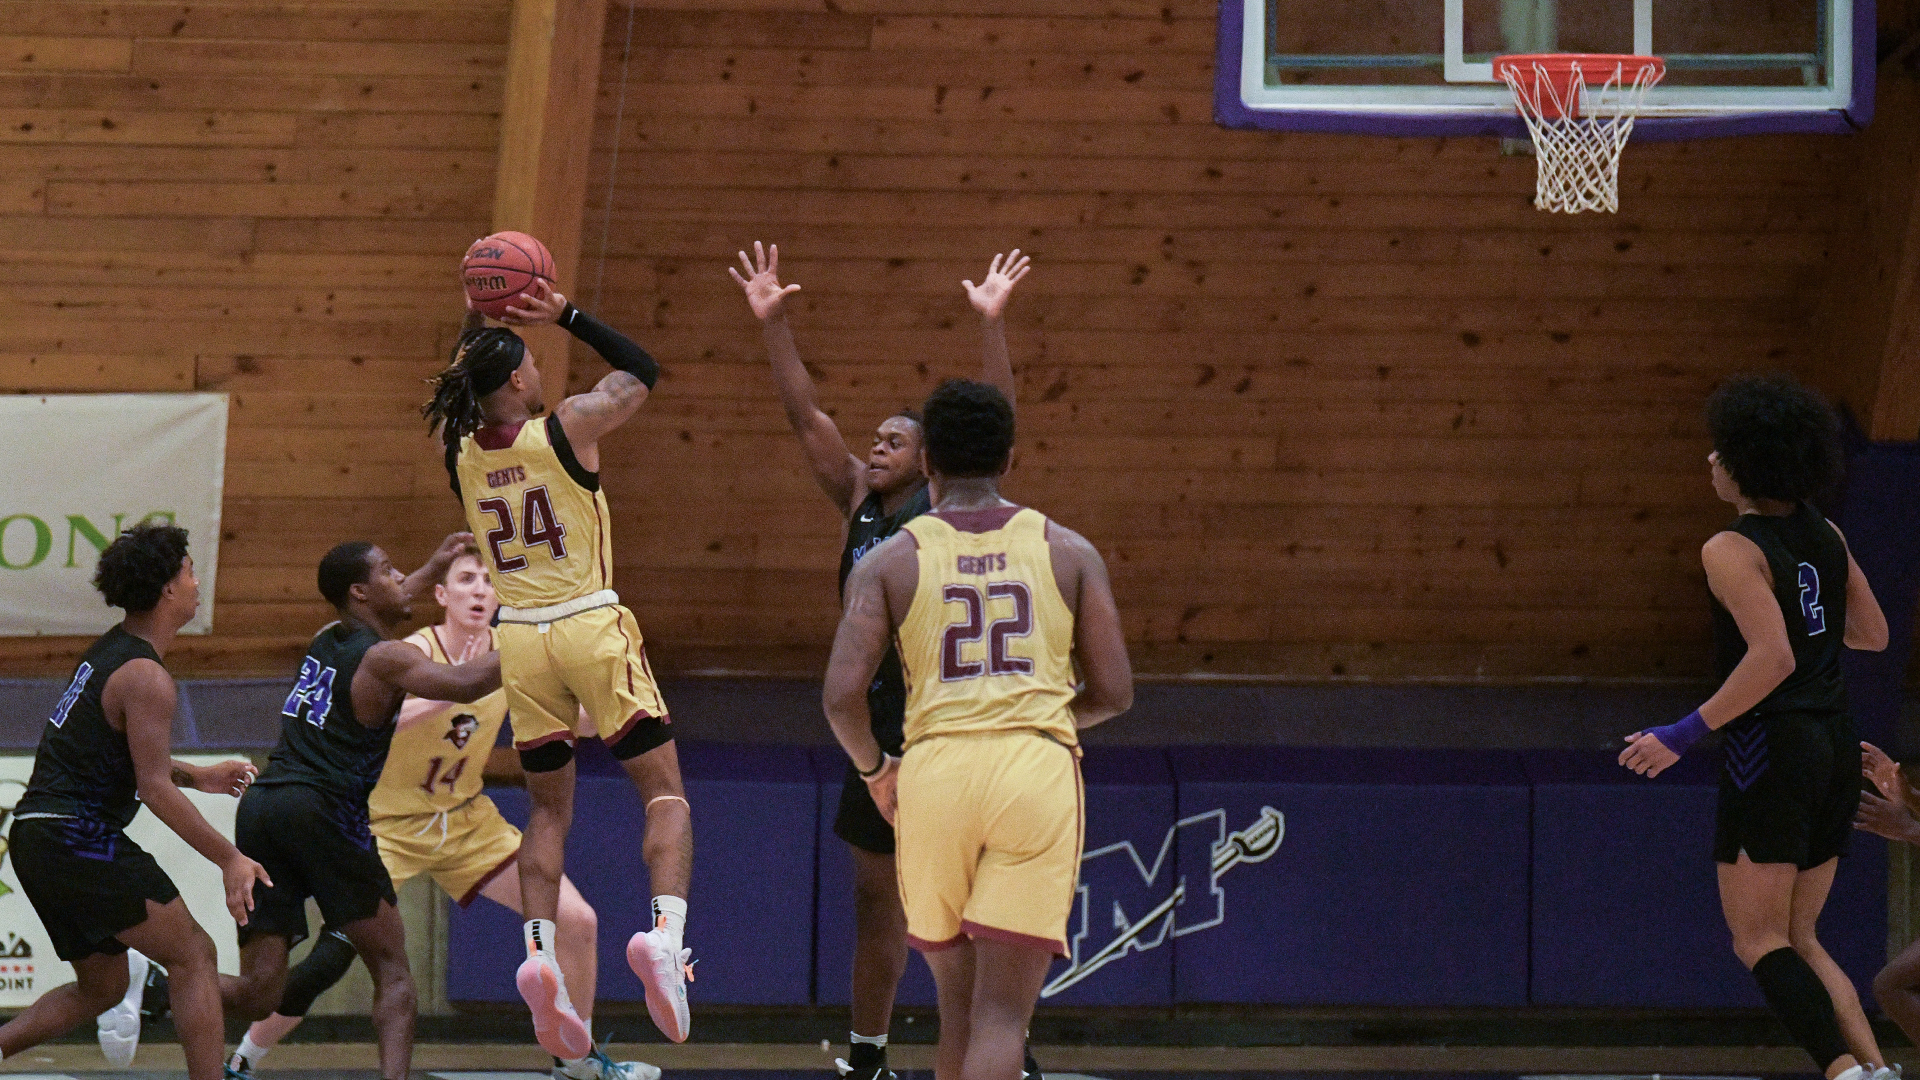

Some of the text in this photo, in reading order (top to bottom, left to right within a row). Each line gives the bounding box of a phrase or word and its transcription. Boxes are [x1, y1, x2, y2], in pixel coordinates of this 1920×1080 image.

[486, 465, 526, 489] GENTS
[476, 484, 567, 574] 24
[957, 552, 1007, 576] GENTS
[939, 580, 1034, 683] 22
[1798, 561, 1826, 636] 2
[281, 655, 337, 730] 24
[419, 756, 470, 794] 14
